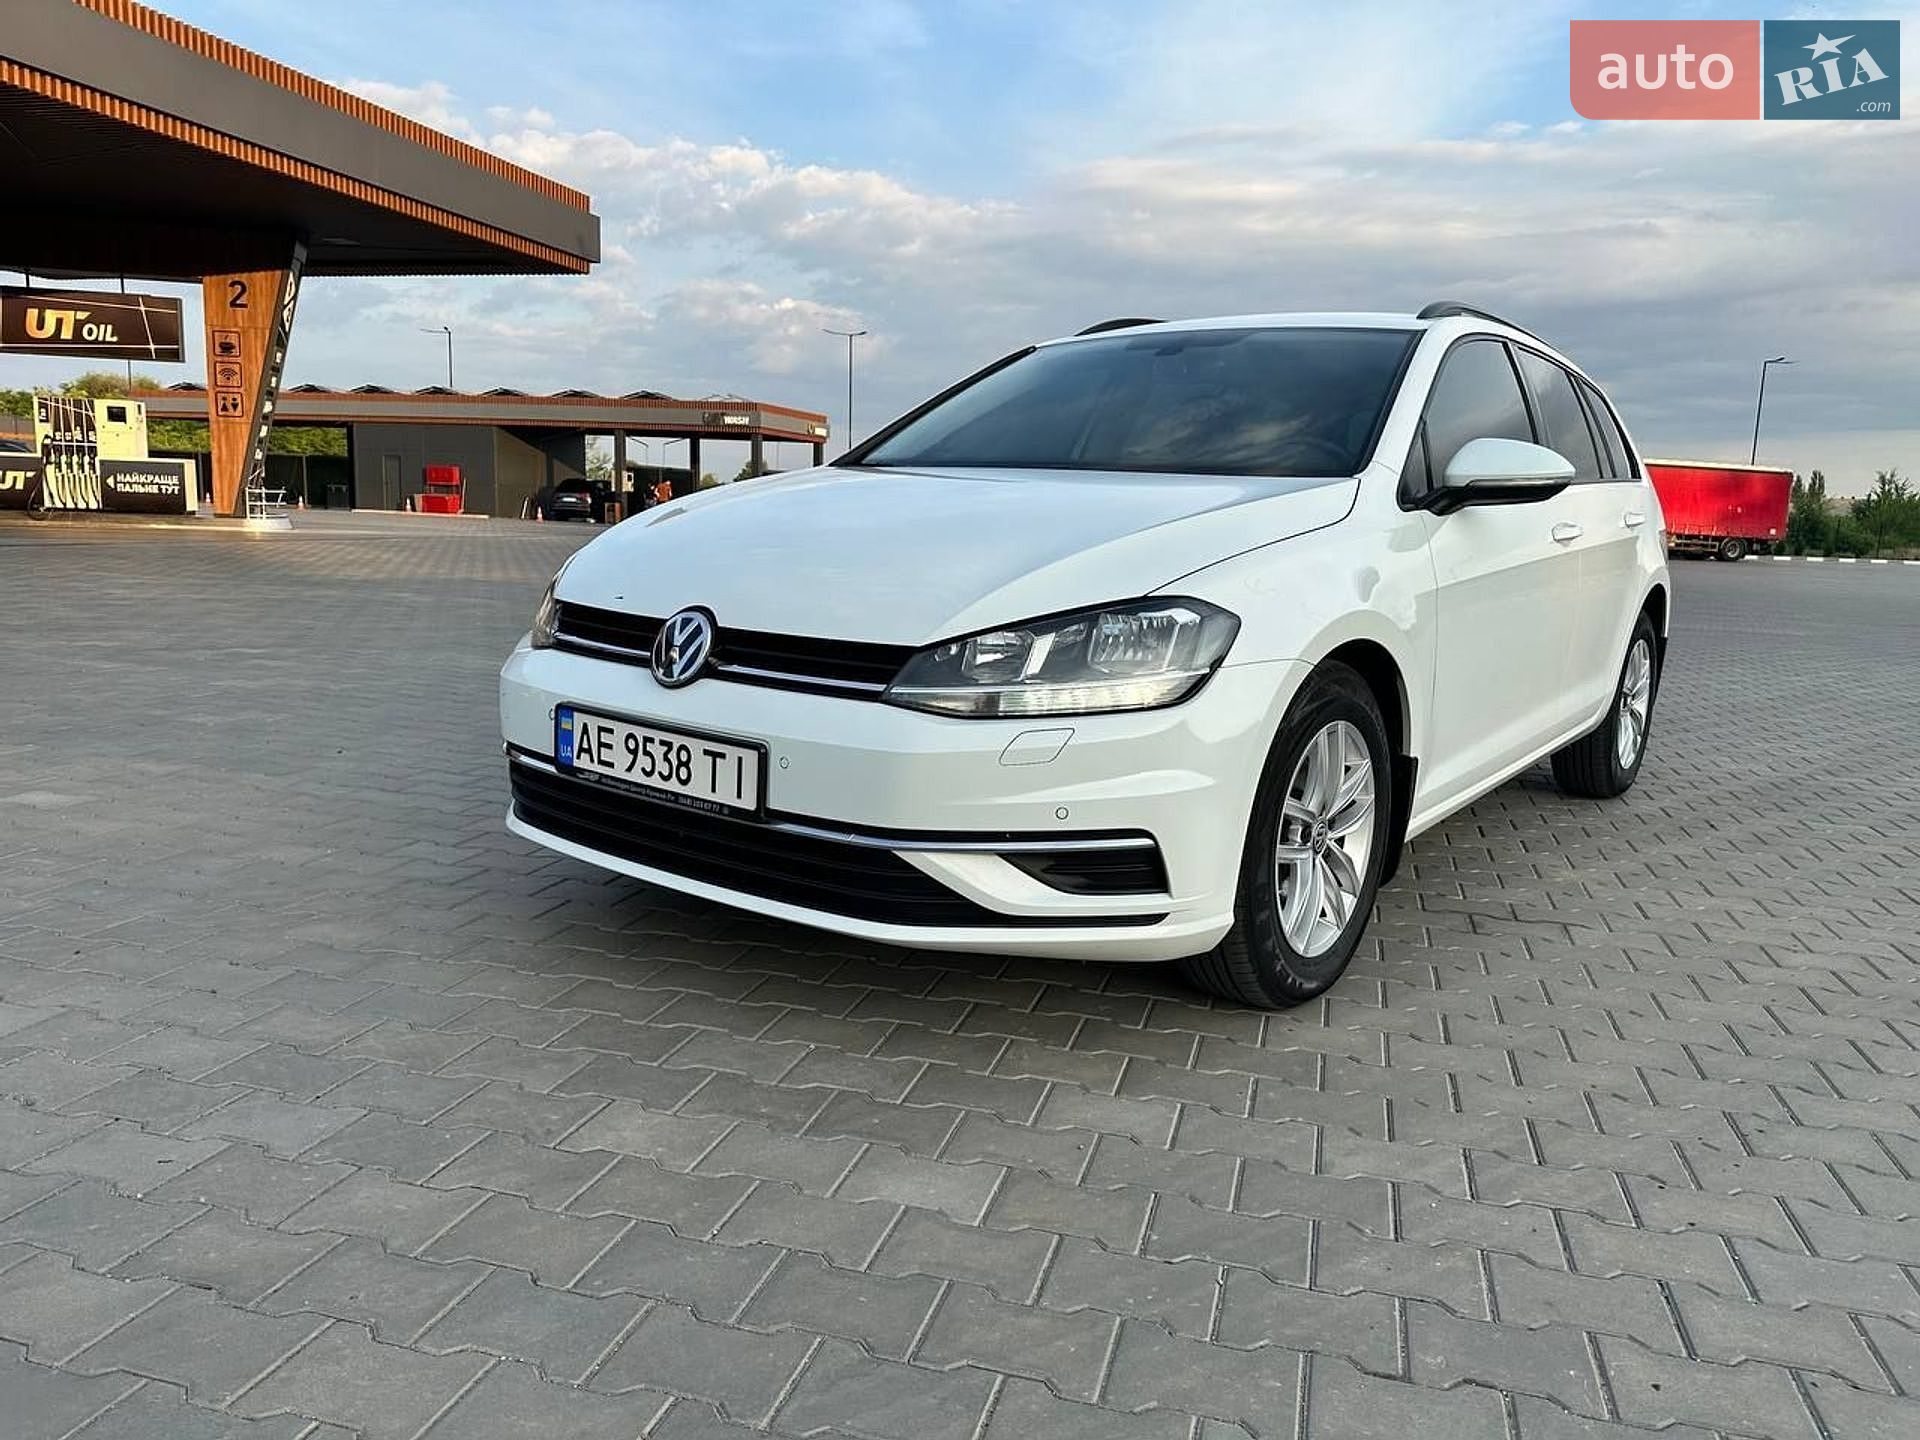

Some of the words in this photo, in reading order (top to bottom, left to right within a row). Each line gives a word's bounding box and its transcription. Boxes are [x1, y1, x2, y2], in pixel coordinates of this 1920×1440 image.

[228, 280, 248, 308] 2
[82, 323, 118, 342] OIL
[116, 472, 179, 485] НАЙКРАЩЕ
[161, 485, 180, 495] ТУТ
[561, 745, 573, 759] UA
[576, 722, 614, 769] AE
[624, 732, 692, 786] 9538
[703, 748, 743, 800] TI
